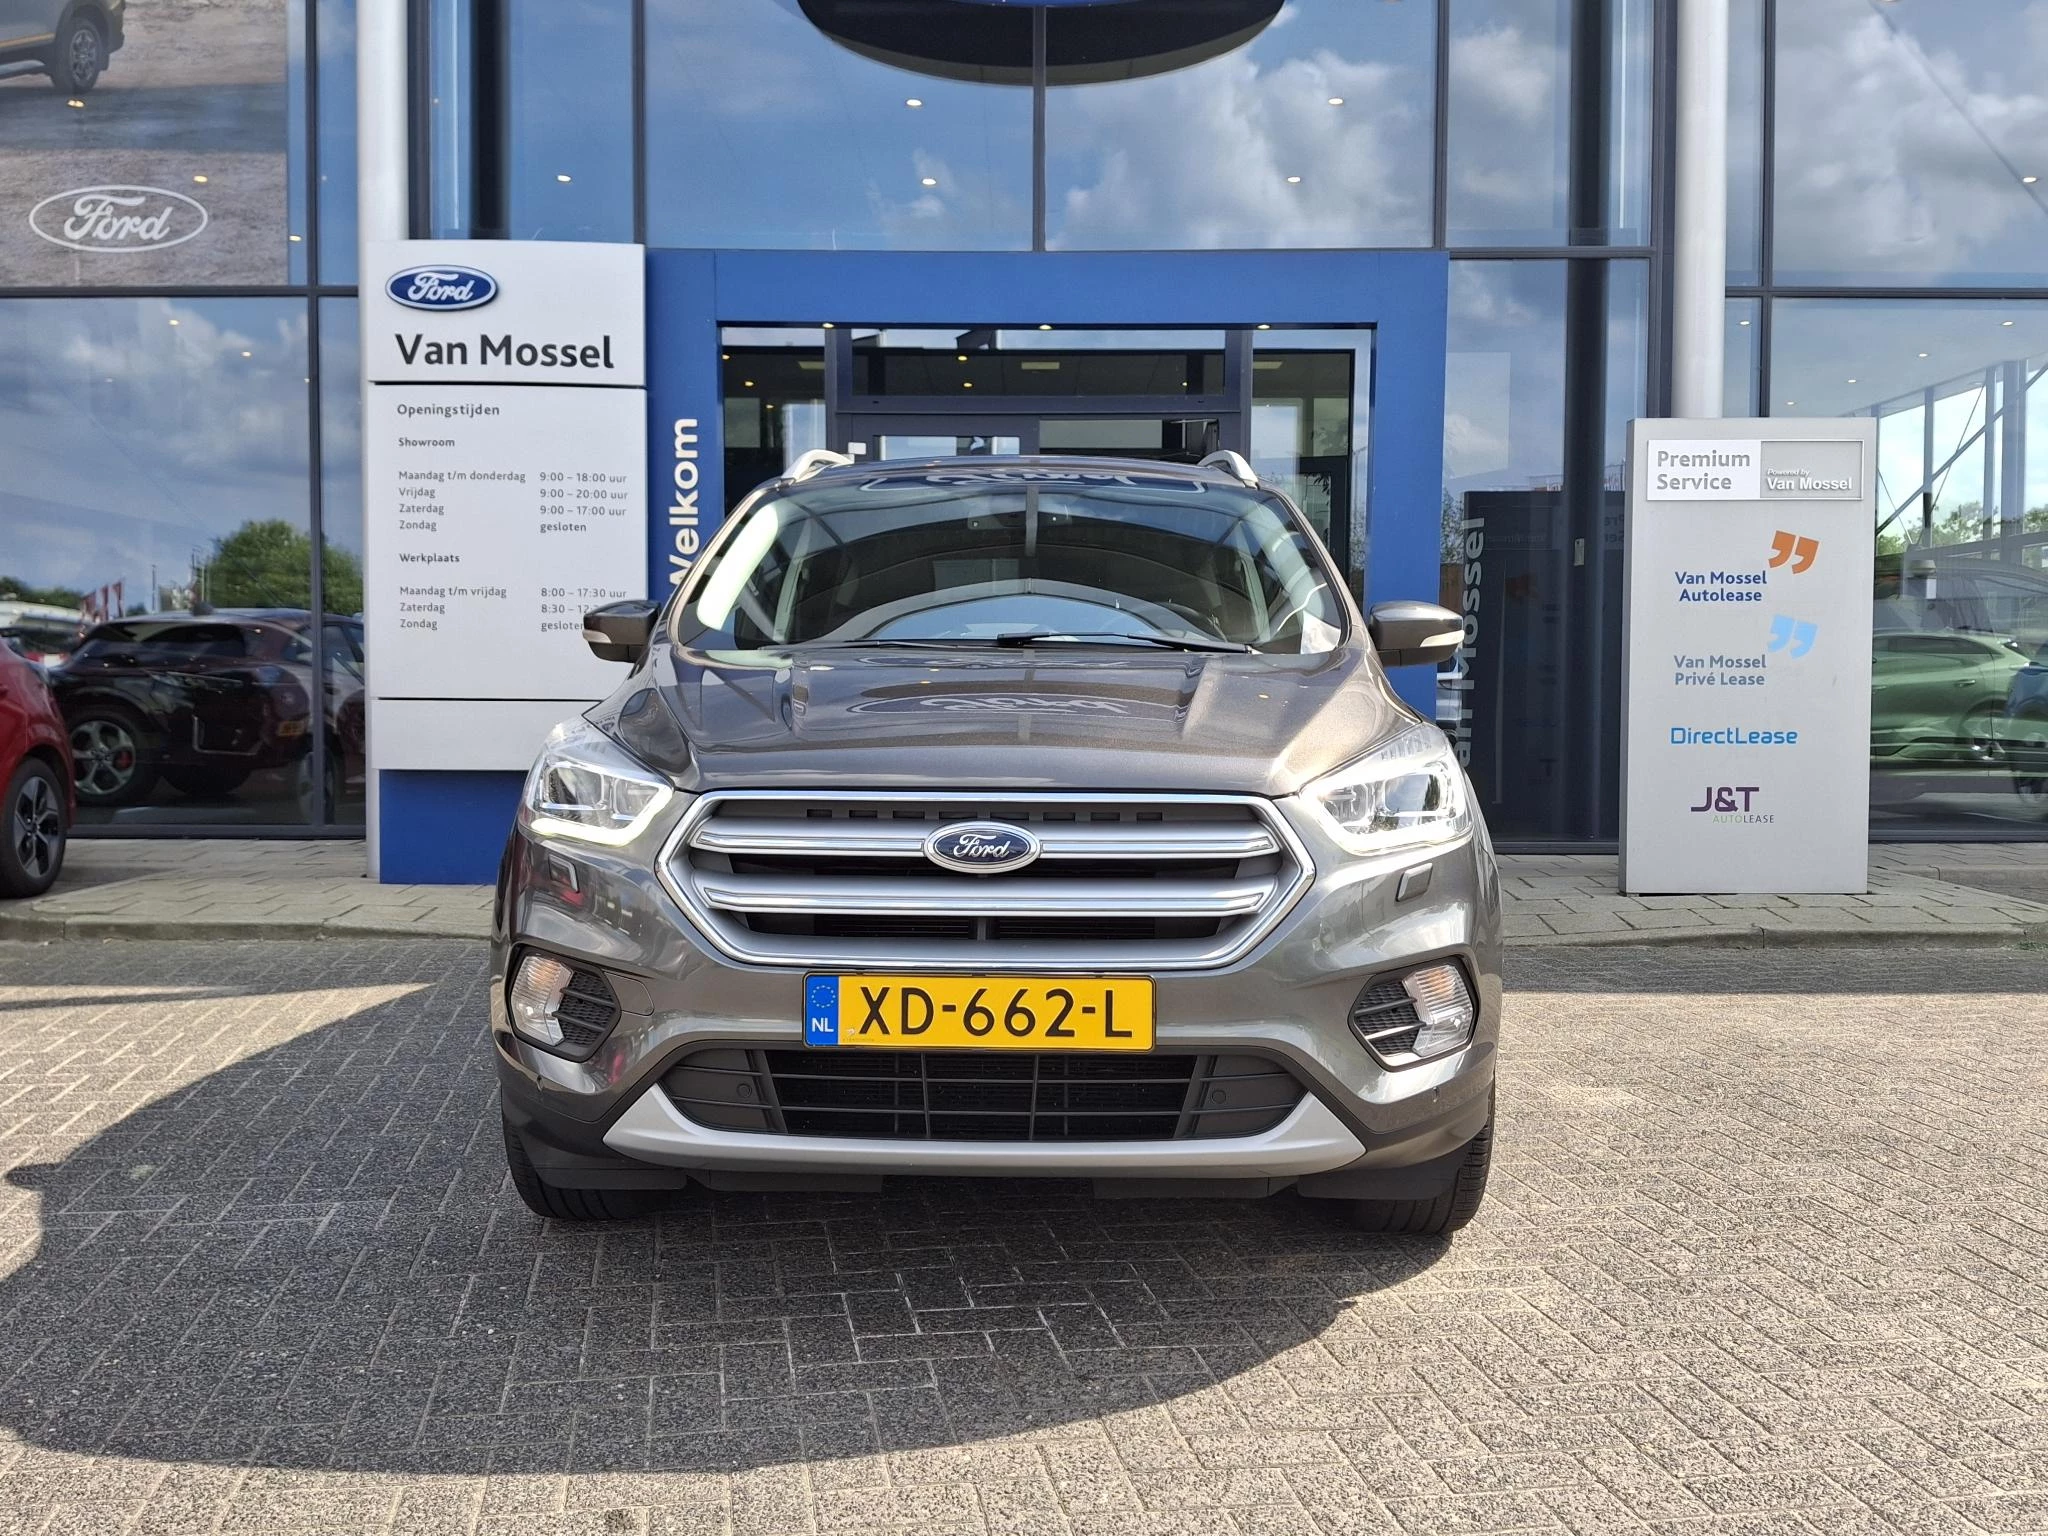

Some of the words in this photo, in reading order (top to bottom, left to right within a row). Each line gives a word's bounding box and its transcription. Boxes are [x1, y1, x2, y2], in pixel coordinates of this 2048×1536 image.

[63, 193, 173, 241] Ford
[407, 271, 474, 301] Ford
[394, 333, 469, 366] Van
[479, 333, 615, 370] Mossel
[396, 403, 500, 419] Openingstijden
[398, 436, 456, 447] Showroom
[1657, 449, 1751, 468] Premium
[398, 470, 445, 483] Maandag
[447, 470, 467, 481] t/m
[469, 470, 527, 484] donderdag
[539, 471, 564, 482] 9:00
[576, 472, 606, 483] 18:00
[609, 475, 627, 483] uur
[1656, 472, 1732, 490] Service
[1767, 468, 1797, 477] Powered
[1798, 469, 1811, 479] by
[1767, 476, 1796, 491] Van
[1799, 477, 1853, 491] Mossel
[398, 487, 436, 500] Vrijdag
[539, 488, 565, 499] 9:00
[576, 488, 608, 499] 20:00
[610, 492, 628, 500] uur
[399, 503, 445, 516] Zaterdag
[539, 504, 565, 515] 9:00
[576, 505, 606, 516] 17:00
[608, 508, 627, 517] uur
[399, 519, 438, 533] Zondag
[539, 521, 587, 534] gesloten
[398, 552, 461, 566] Werkplaats
[1674, 571, 1706, 585] Van
[1710, 569, 1768, 585] Mossel
[399, 585, 446, 599] Maandag
[448, 585, 468, 597] t/m
[470, 586, 507, 599] vrijdag
[540, 587, 566, 598] 8:00
[577, 587, 606, 598] 17:30
[1678, 587, 1763, 602] Autolease
[399, 602, 446, 615] Zaterdag
[540, 603, 566, 614] 8:30
[577, 603, 600, 613] 12:
[1452, 517, 1485, 690] Mossel
[399, 618, 438, 632] Zondag
[1673, 655, 1705, 669] Van
[1709, 653, 1767, 669] Mossel
[1674, 671, 1716, 686] Privé
[1720, 671, 1765, 686] Lease
[1454, 709, 1473, 768] an
[1670, 727, 1798, 745] DirectLease
[1690, 786, 1760, 813] J&T
[1712, 814, 1775, 824] AUTOLEASE
[954, 834, 1012, 858] Ford
[811, 1017, 834, 1033] NL
[858, 986, 1133, 1039] XD-662-L
